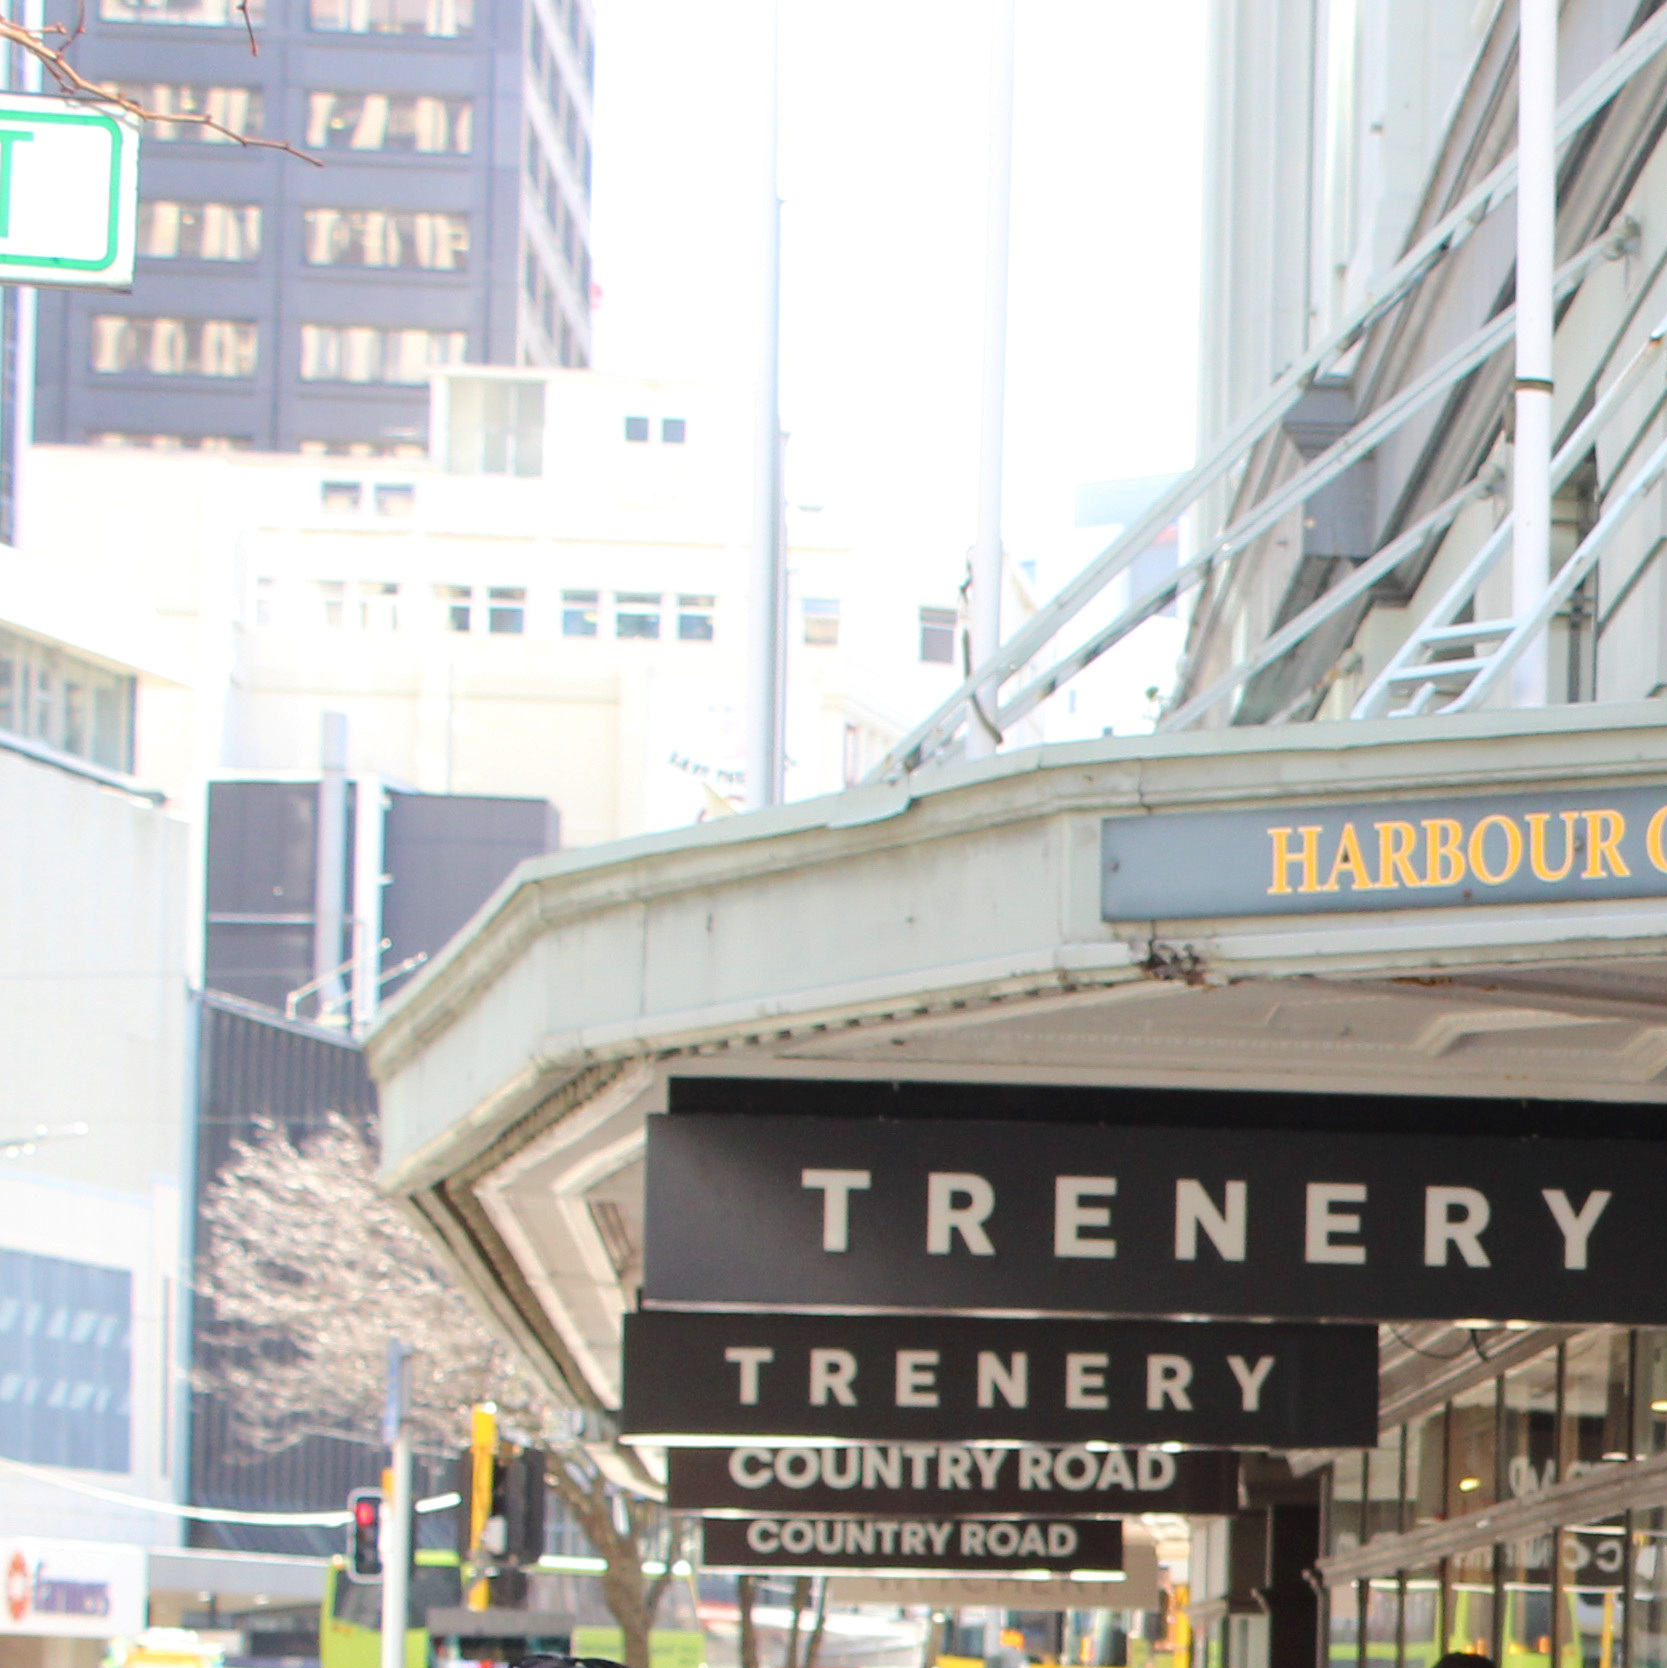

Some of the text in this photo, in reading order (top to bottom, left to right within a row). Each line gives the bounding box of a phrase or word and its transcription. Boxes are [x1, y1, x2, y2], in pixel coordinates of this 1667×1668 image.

[1268, 808, 1632, 895] HARBOUR
[802, 1169, 1612, 1270] TRENERY
[725, 1347, 1276, 1413] TRENERY
[728, 1446, 1177, 1492] COUNTRY ROAD
[746, 1520, 1078, 1558] COUNTRY ROAD
